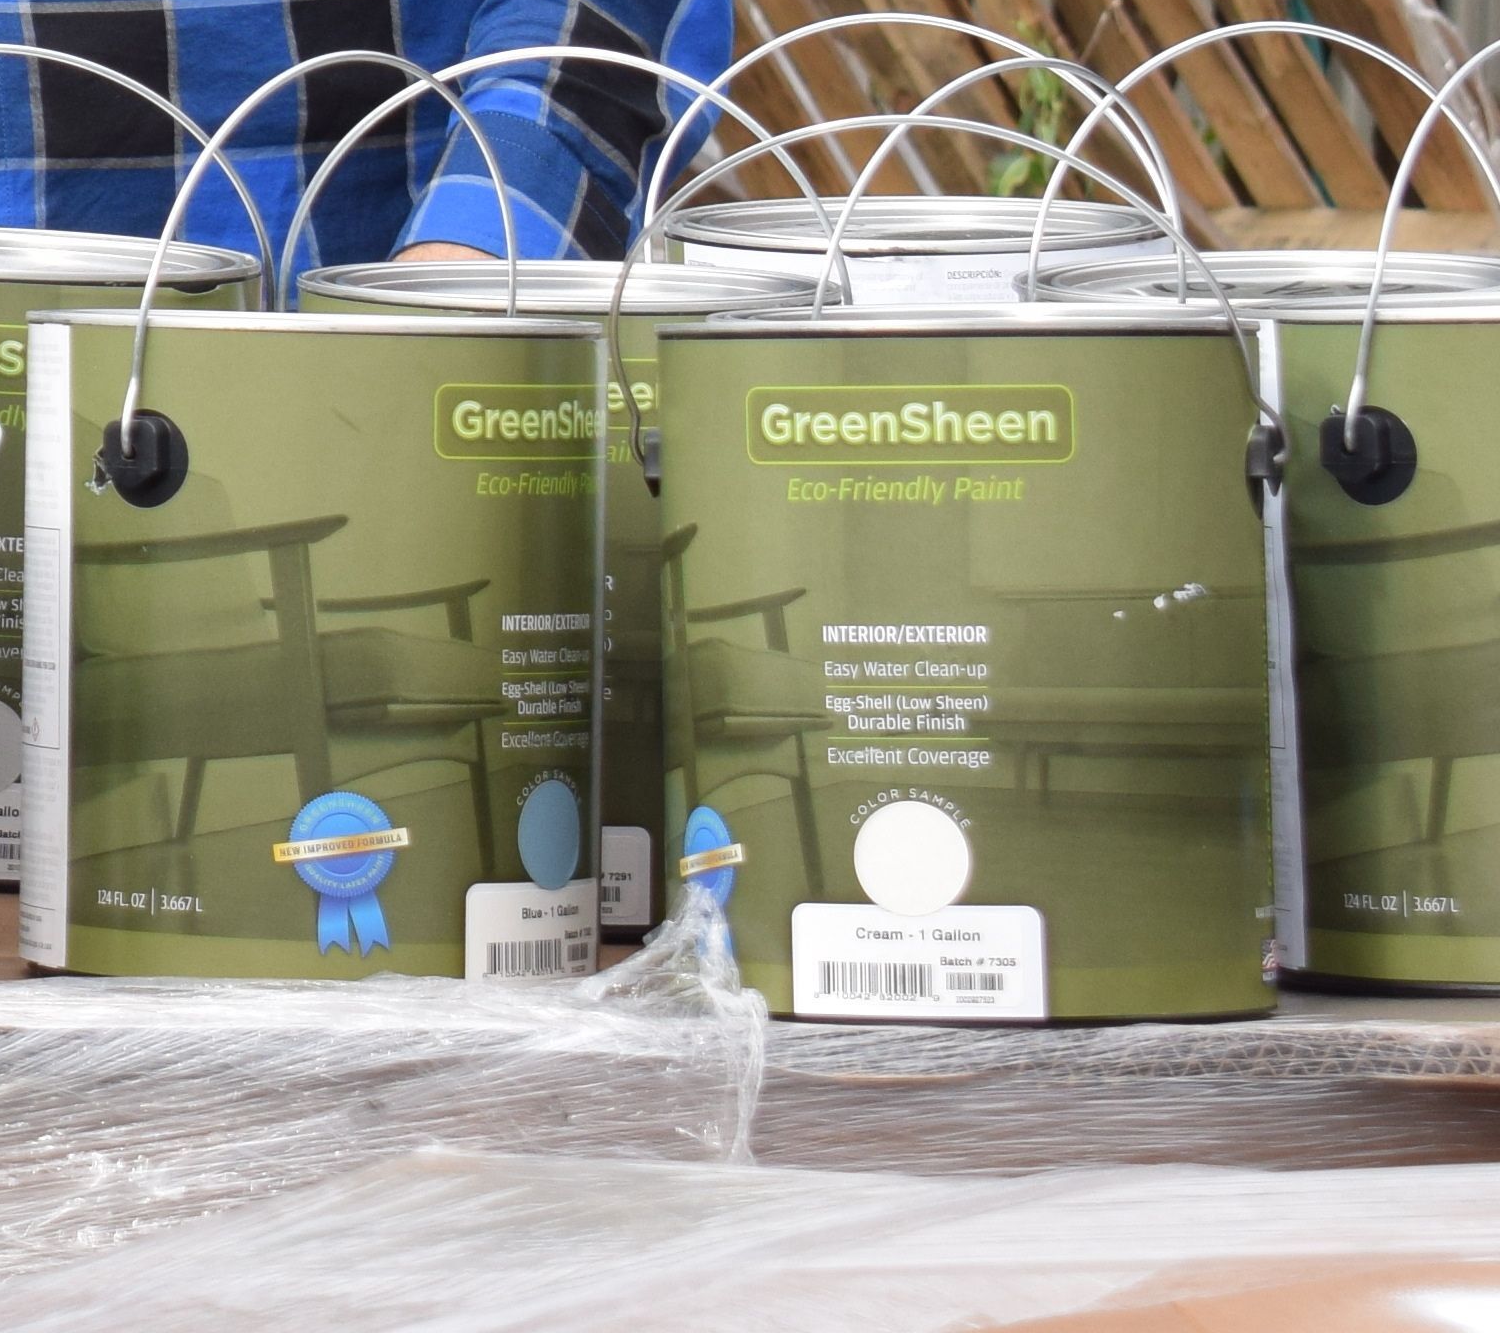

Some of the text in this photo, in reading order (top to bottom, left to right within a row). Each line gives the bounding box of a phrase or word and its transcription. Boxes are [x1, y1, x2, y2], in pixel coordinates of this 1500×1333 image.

[761, 400, 1057, 445] GreenSheen
[476, 471, 577, 497] Eco-Friendly
[787, 475, 1024, 505] Eco-Friendly Paint
[502, 613, 590, 632] INTERIOR/EXTERIOR
[822, 624, 988, 644] INTERIOR/EXTERIOR
[502, 648, 557, 666] Easy Water
[824, 660, 987, 680] Easy Water Clean-up
[502, 681, 568, 699] Egg-Shell (Low
[518, 698, 582, 715] Durable Finish
[825, 694, 988, 712] Egg-Shell (Low Sheen)
[848, 713, 965, 731] Durable Finish
[501, 731, 551, 748] Excellent
[827, 746, 990, 769] Excellent Coverage
[516, 770, 549, 806] COLOR
[849, 788, 972, 830] COLOR SAMPLE
[279, 833, 402, 858] NEW IMPROVED FORMULA
[97, 889, 203, 912] 124 FL. OZ 3.667 L
[1343, 893, 1460, 912] 124 FL. OZ 3.667 L
[522, 907, 543, 919] Blue
[855, 927, 904, 942] Cream
[931, 928, 982, 943] Gallon
[940, 956, 1017, 967] Batch # 7305
